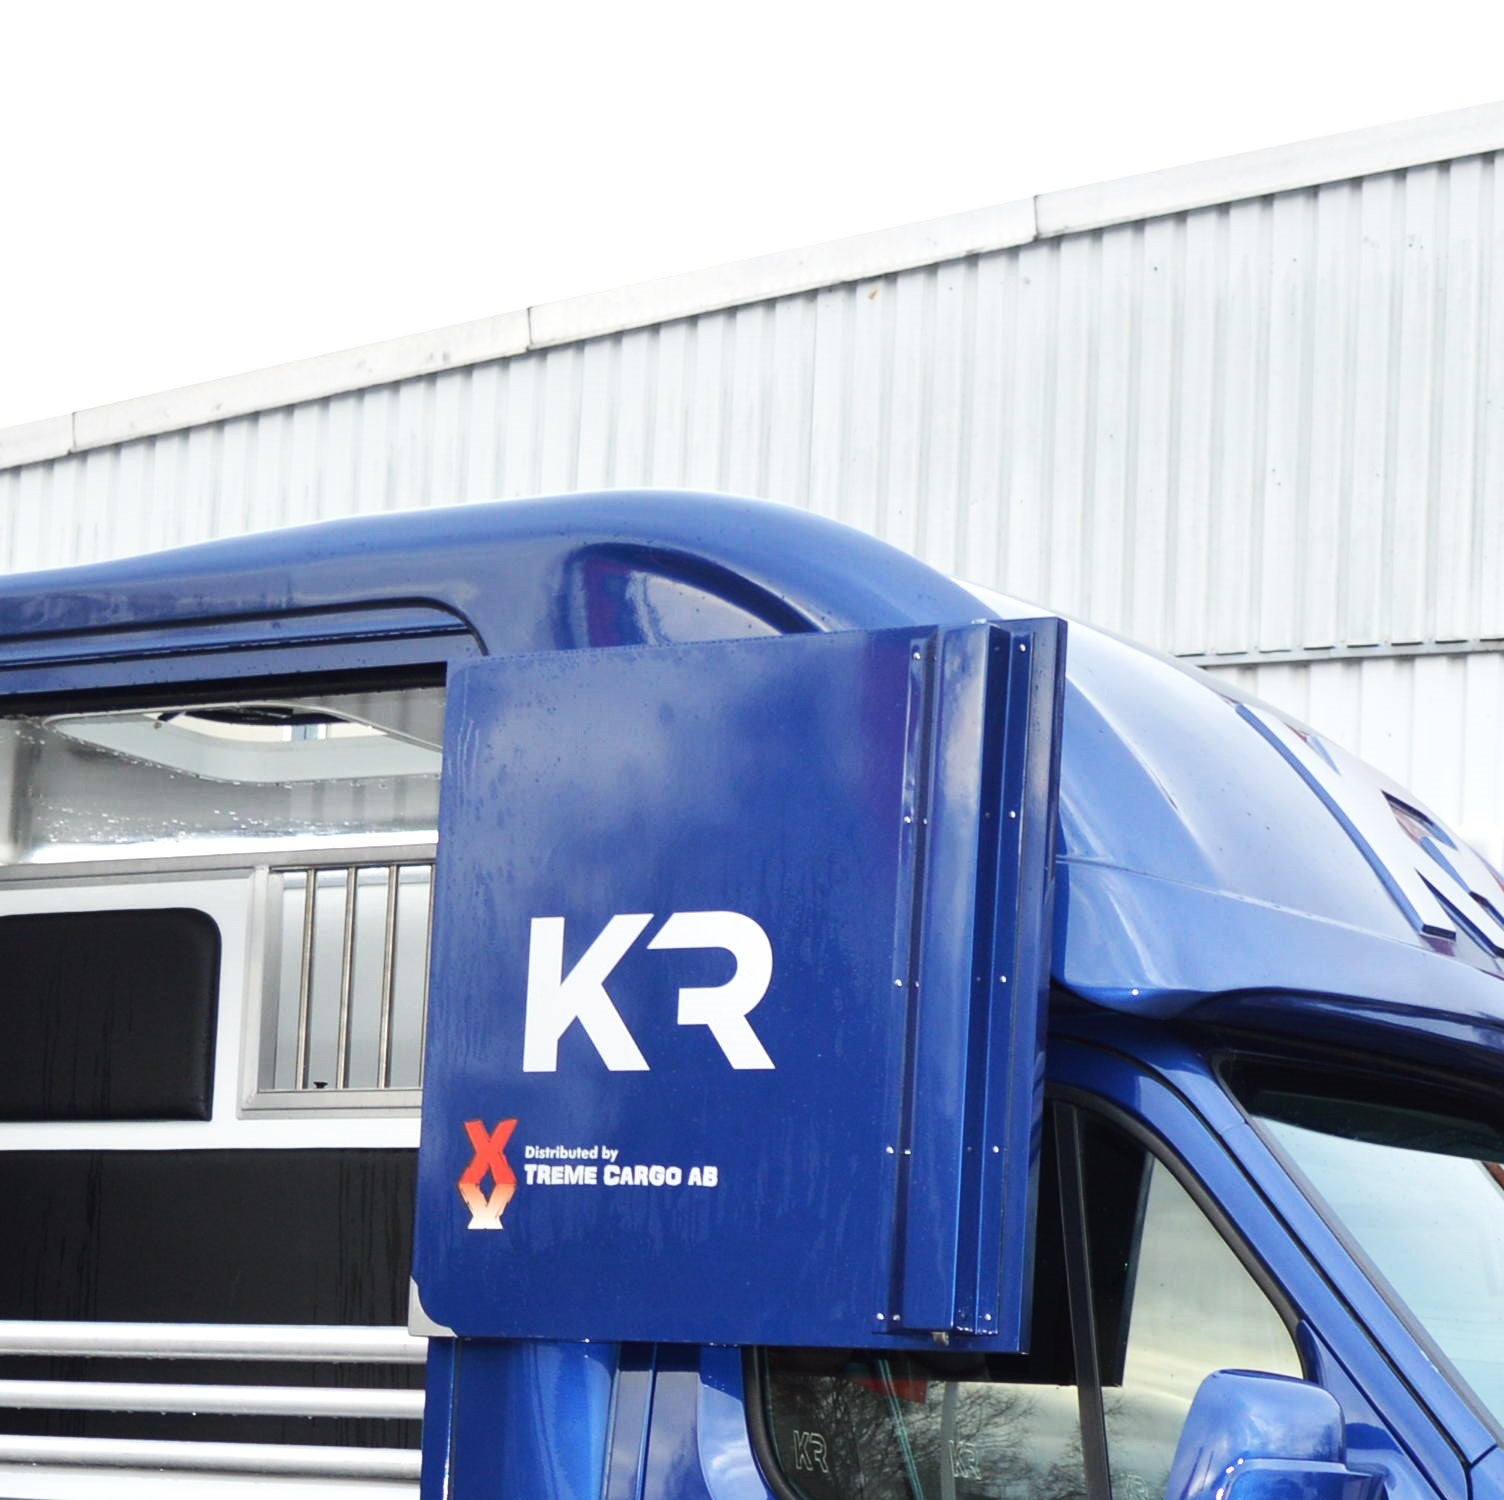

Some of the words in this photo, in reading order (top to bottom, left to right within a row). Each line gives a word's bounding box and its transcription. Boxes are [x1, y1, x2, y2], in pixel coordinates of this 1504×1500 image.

[523, 911, 775, 1072] KR
[524, 1145, 598, 1160] Distributed
[601, 1145, 619, 1162] by
[603, 1164, 683, 1187] CARGO
[687, 1166, 719, 1187] AB
